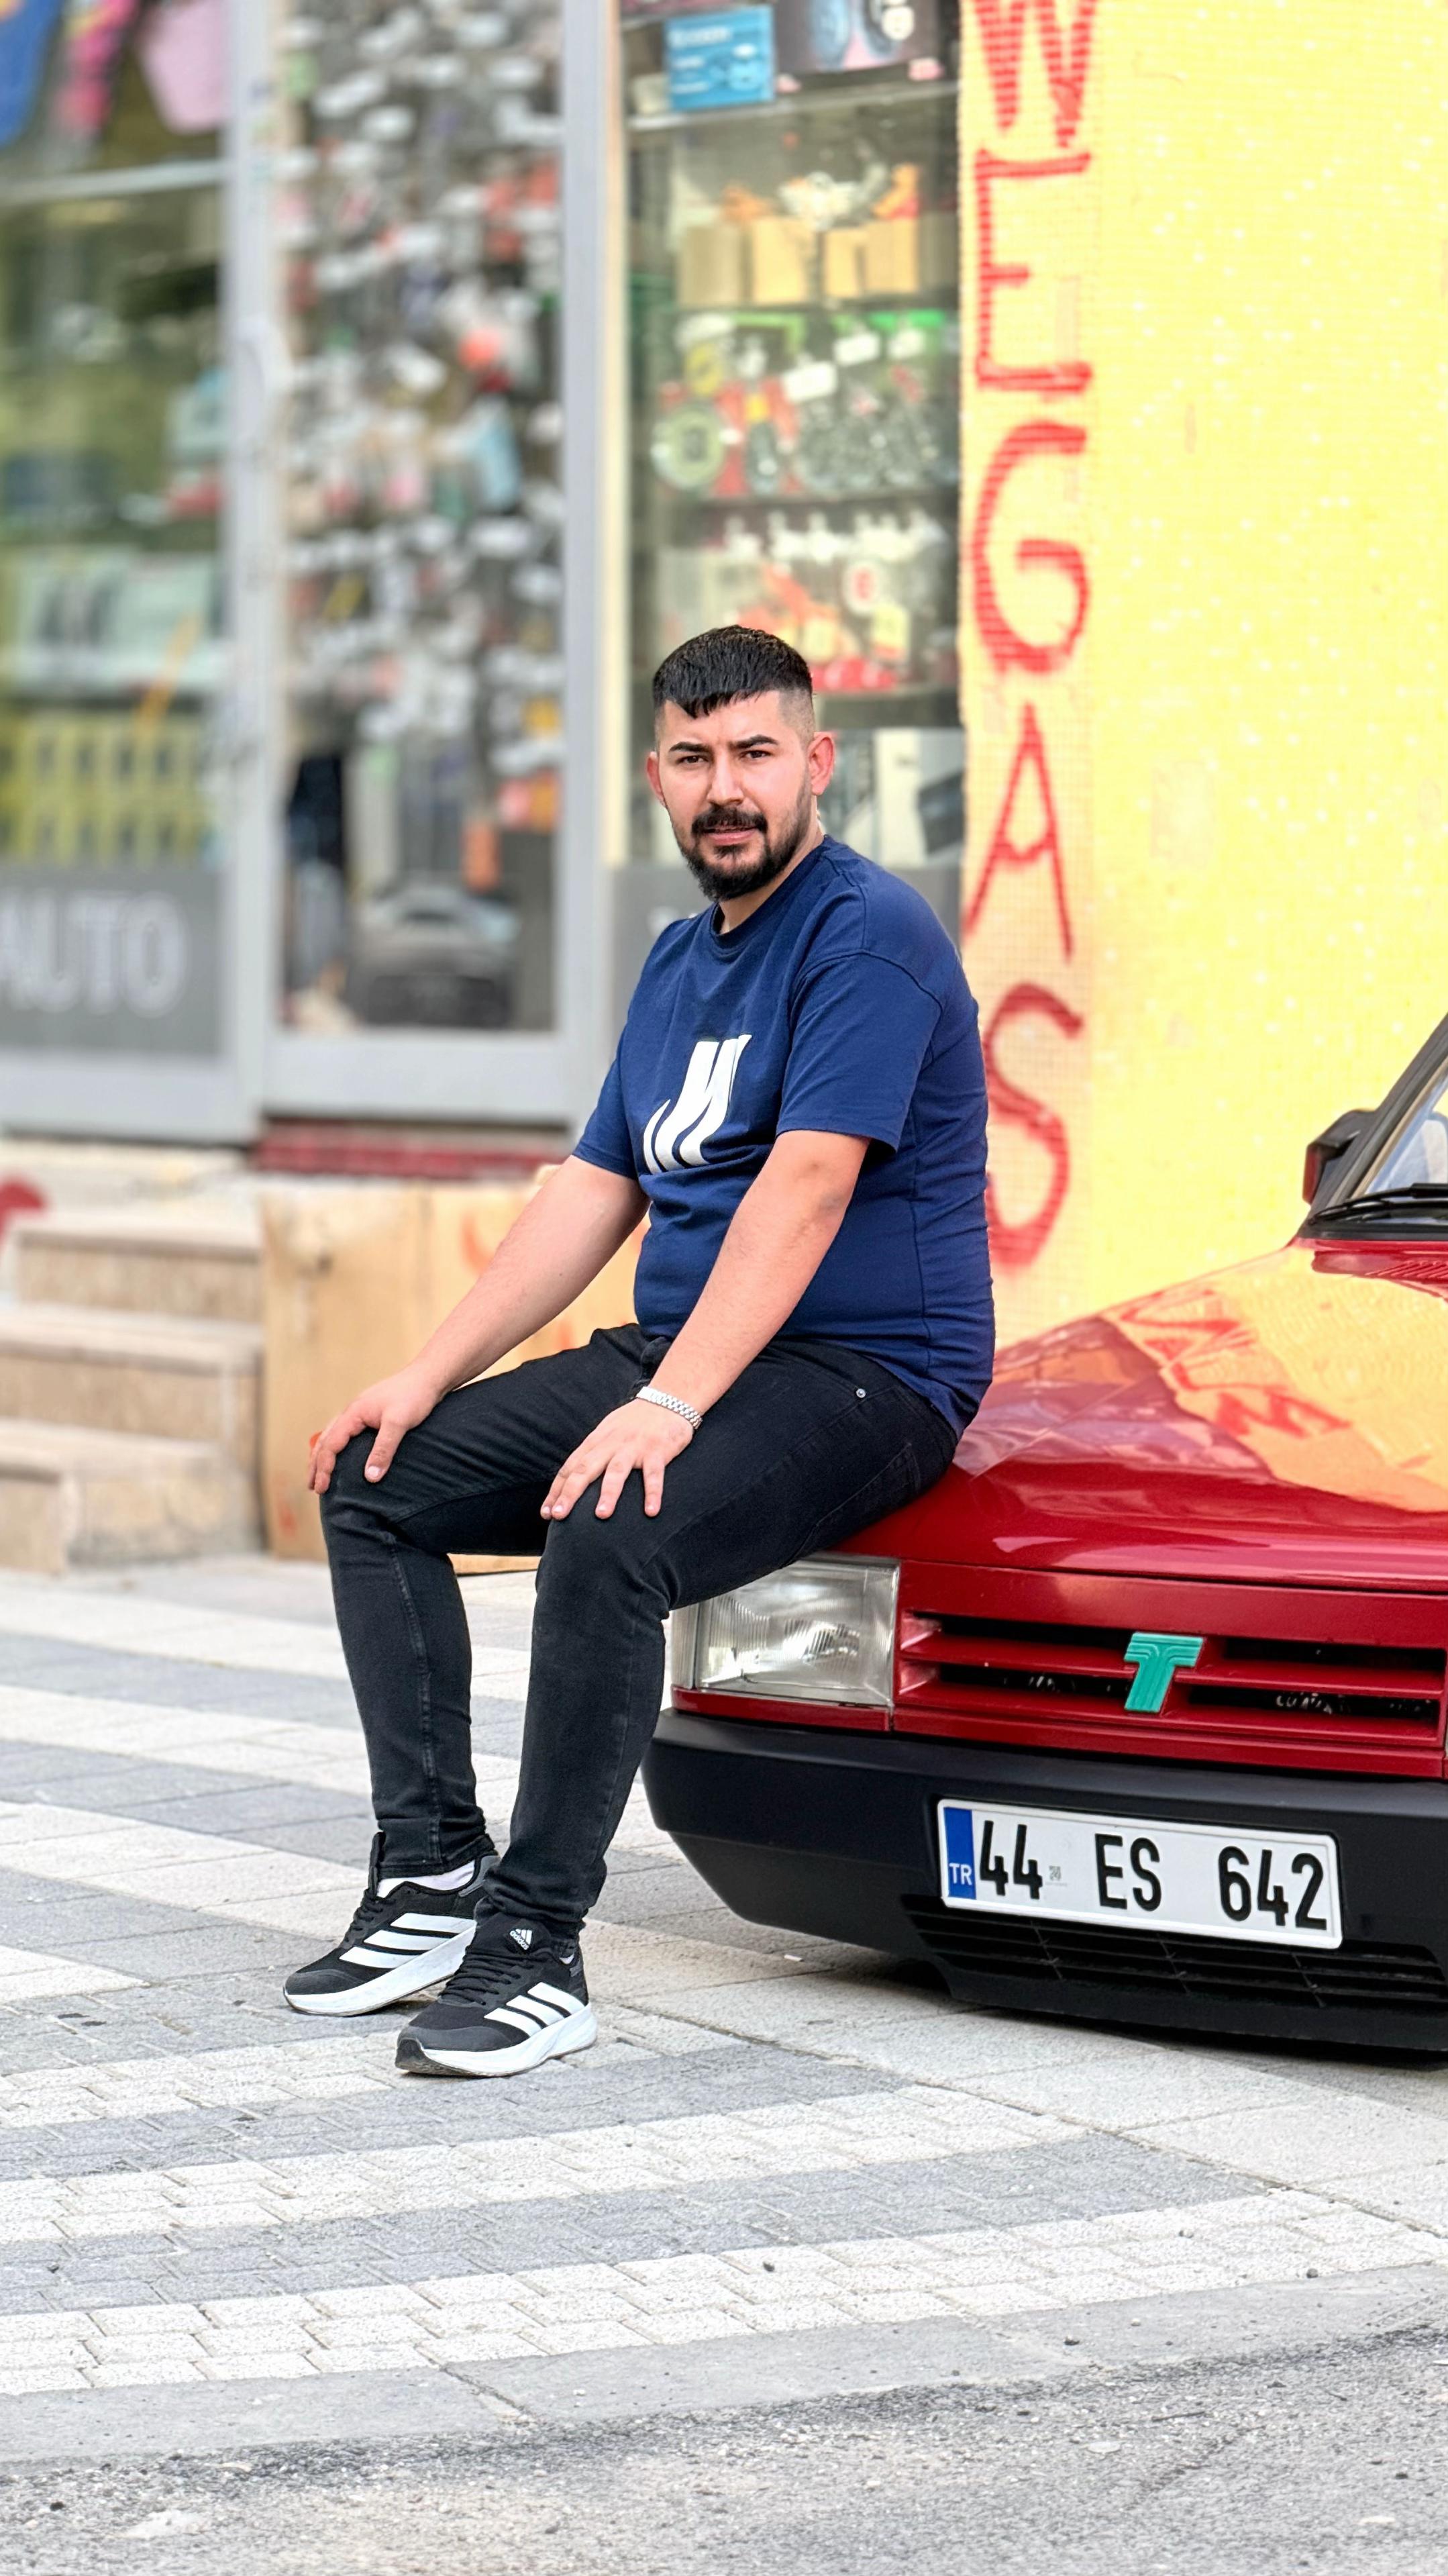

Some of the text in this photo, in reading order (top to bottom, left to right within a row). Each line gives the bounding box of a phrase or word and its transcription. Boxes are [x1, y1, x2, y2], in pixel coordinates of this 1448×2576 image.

[964, 0, 1094, 1275] WEGAS
[1124, 1632, 1203, 1713] T
[949, 1863, 973, 1885] TR
[980, 1820, 1327, 1930] 44 ES 642
[510, 1930, 529, 1950] adidas
